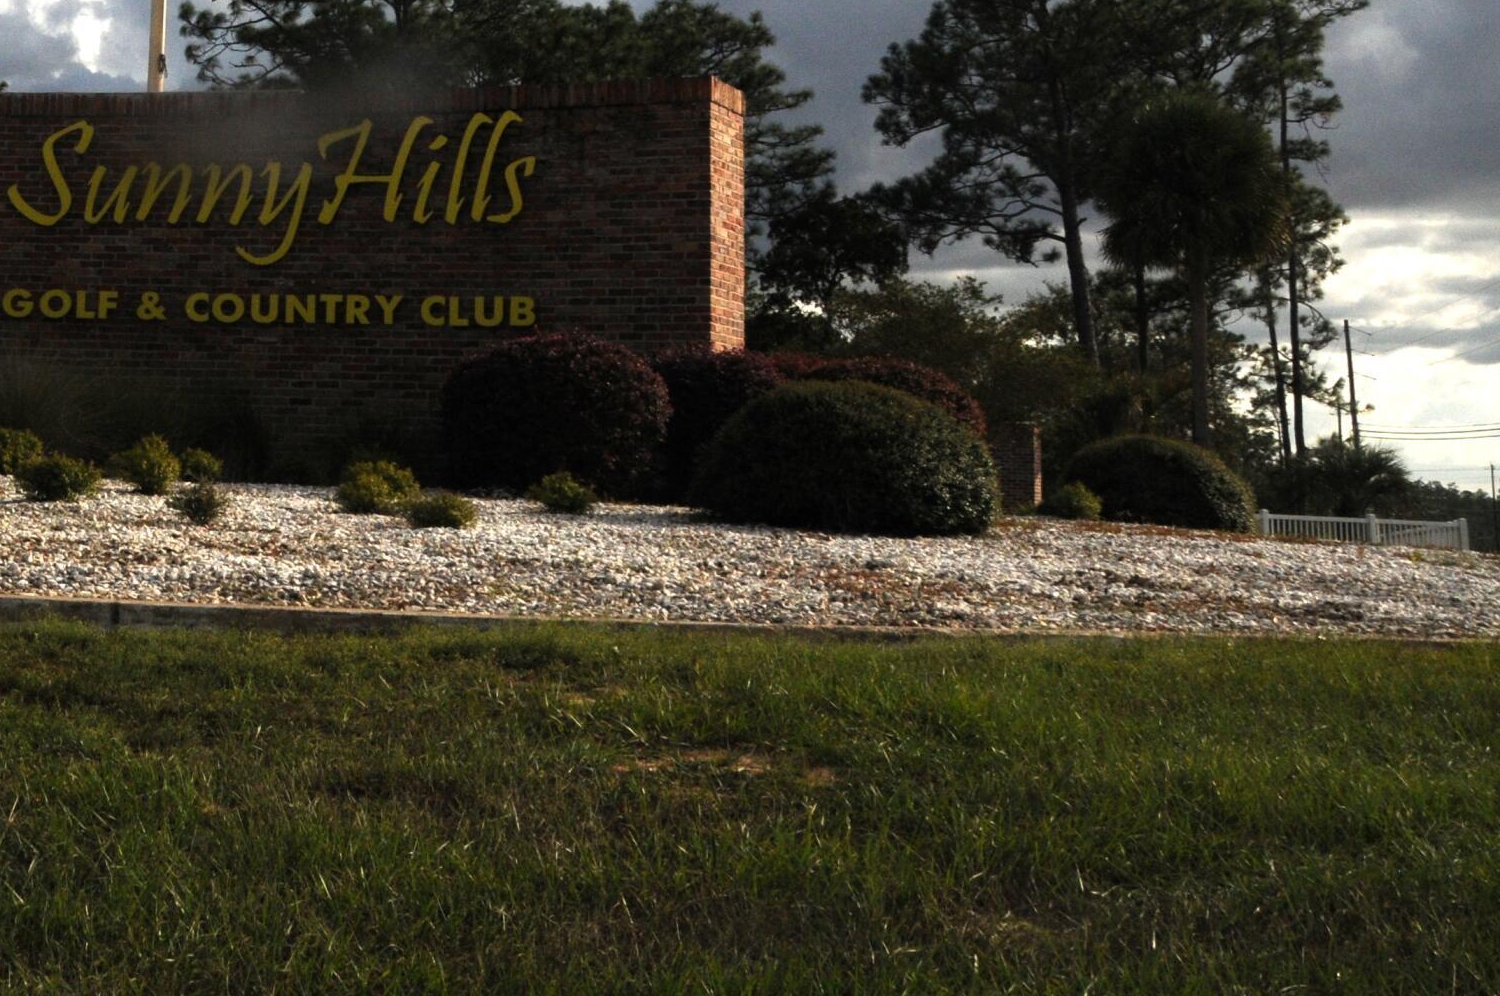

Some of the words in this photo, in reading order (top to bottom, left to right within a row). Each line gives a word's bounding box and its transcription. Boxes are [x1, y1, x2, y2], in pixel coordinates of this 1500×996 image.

[7, 119, 313, 266] Sunny
[317, 110, 536, 225] Hills
[2, 288, 119, 320] GOLF
[136, 291, 166, 321] &
[185, 292, 404, 325] COUNTRY
[420, 295, 537, 328] CLUB
